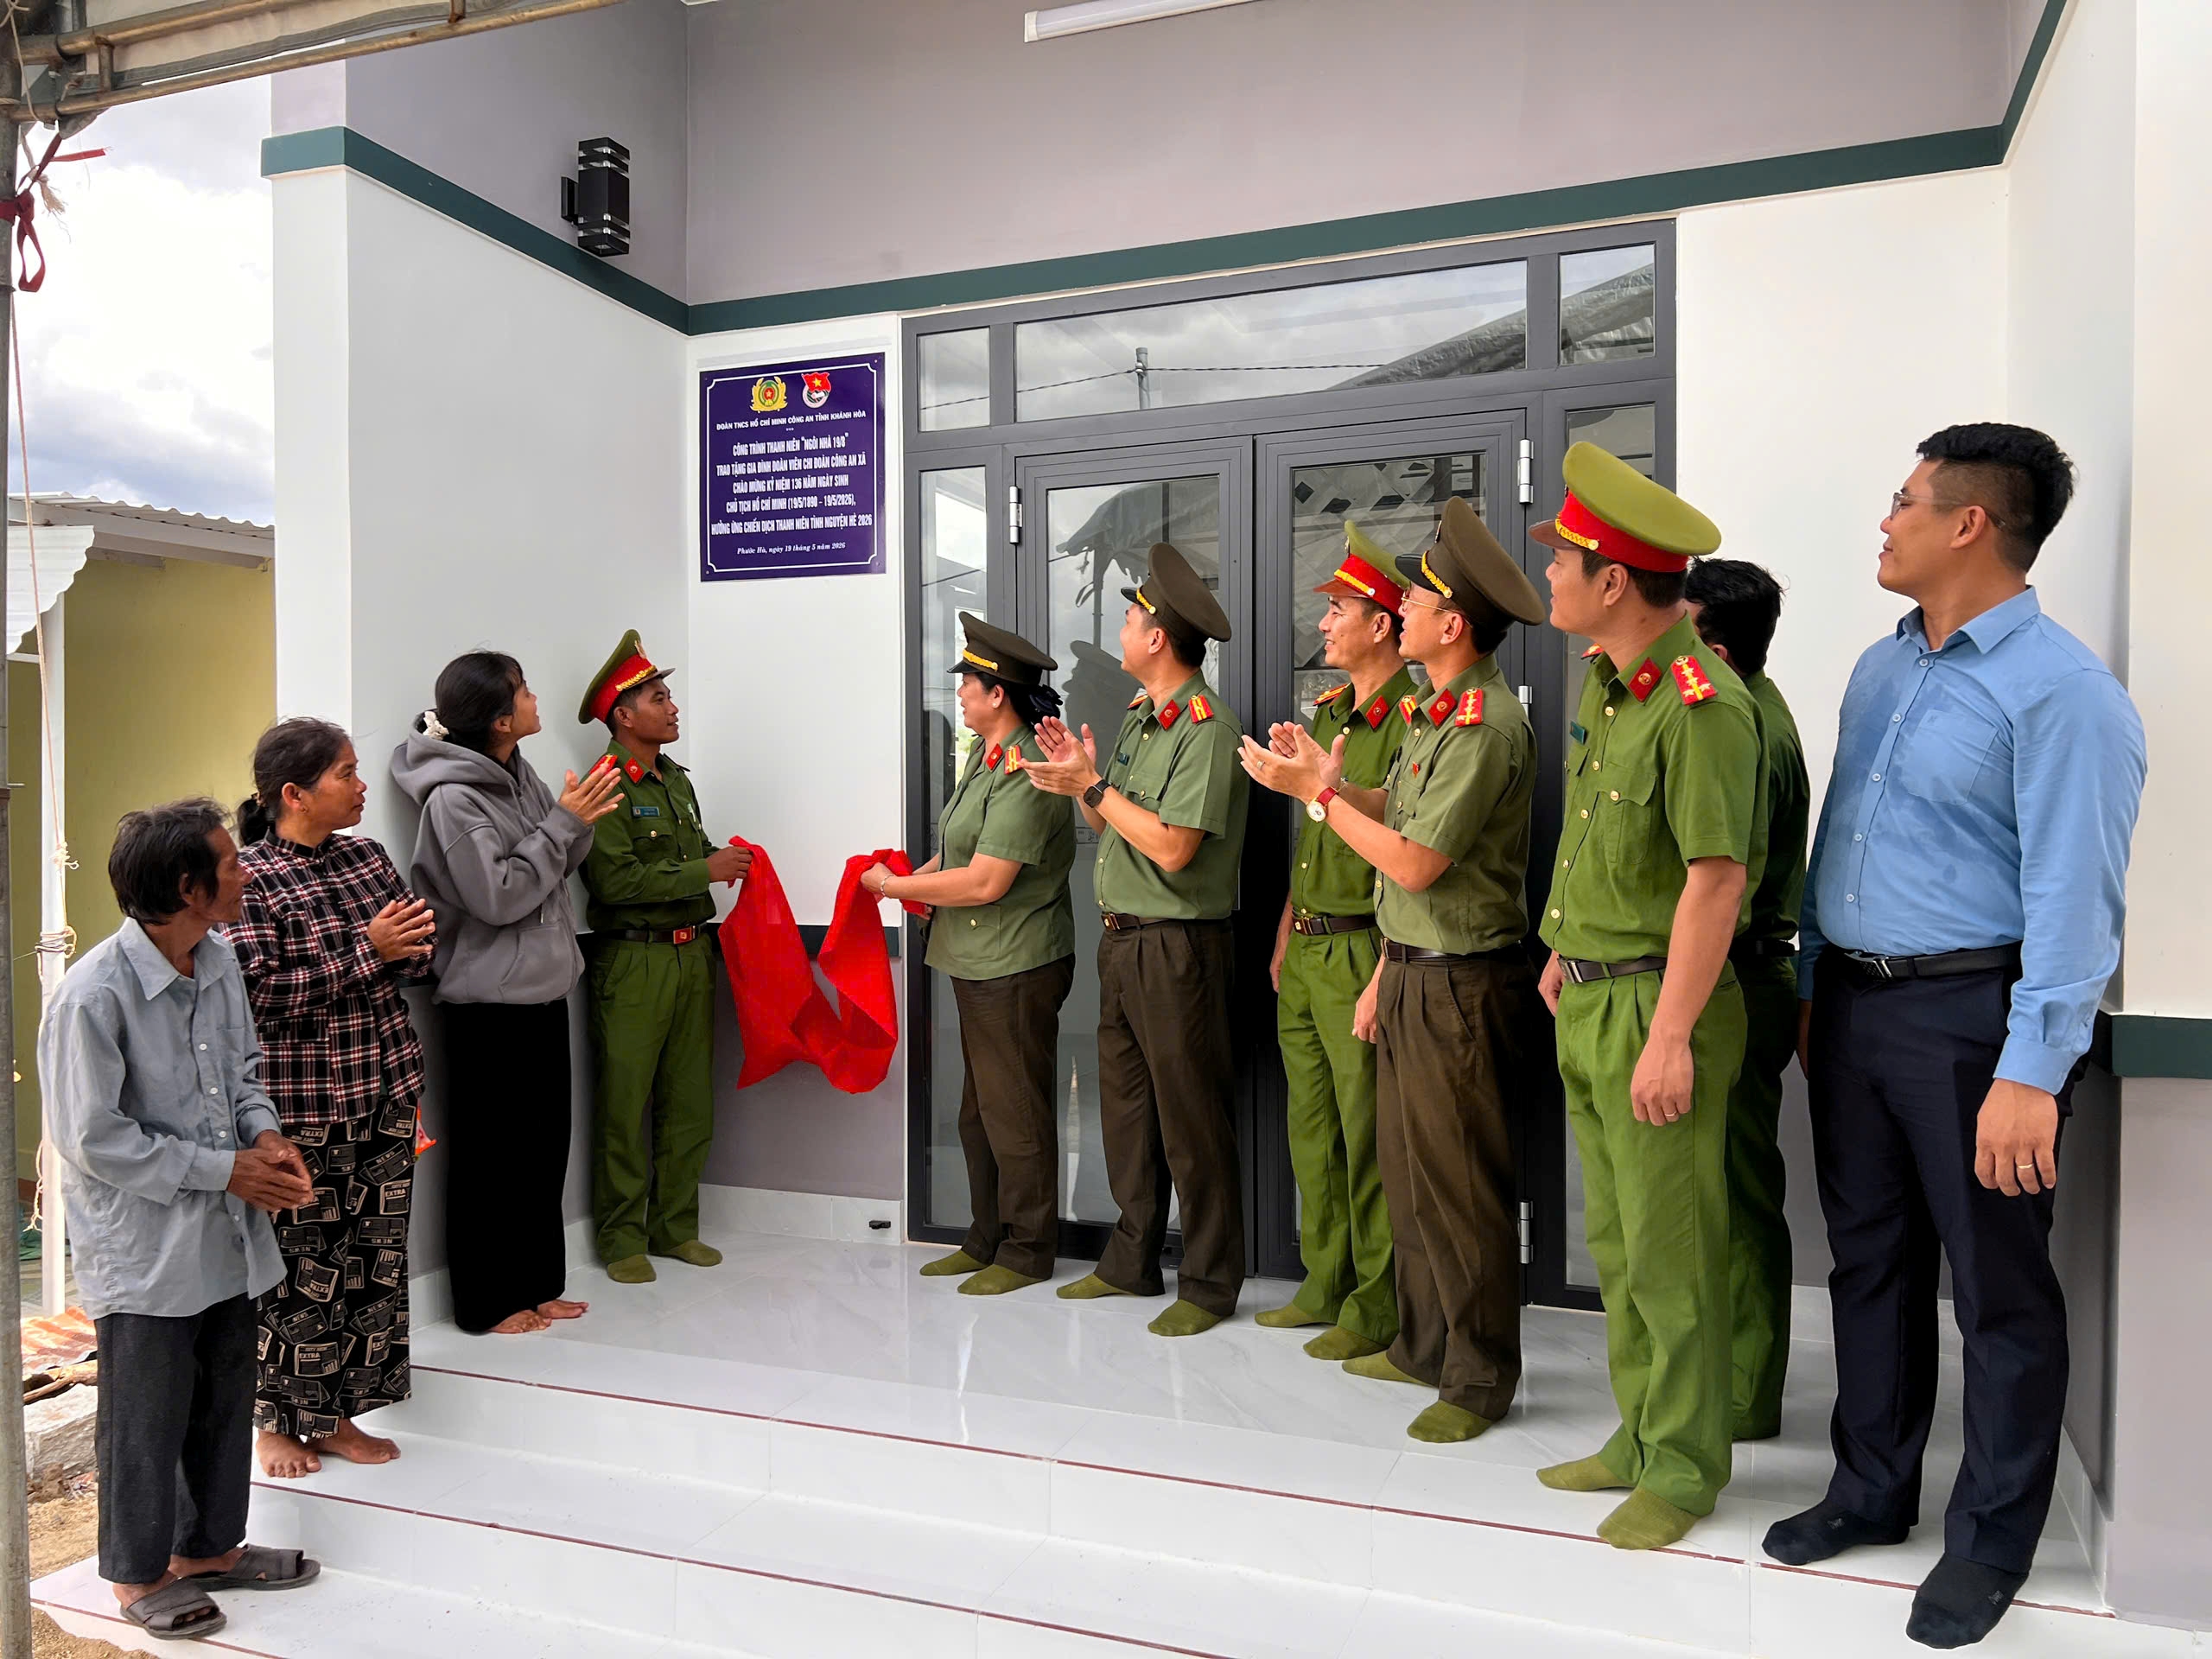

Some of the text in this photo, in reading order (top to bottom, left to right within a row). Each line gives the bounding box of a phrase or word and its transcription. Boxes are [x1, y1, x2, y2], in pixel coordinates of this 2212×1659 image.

[716, 422, 733, 430] ĐOÀN
[734, 421, 749, 429] TNCS
[750, 417, 759, 427] HỒ
[760, 417, 771, 427] CHÍ
[771, 417, 787, 426] MINH
[787, 415, 804, 424] CÔNG
[830, 410, 852, 421] KHÁNH
[853, 409, 867, 418] HÒA
[733, 442, 748, 457] CÔNG
[749, 441, 766, 455] TRÌNH
[766, 441, 785, 454] THANH
[785, 437, 801, 452] NIÊN
[819, 434, 832, 449] NHÀ
[716, 451, 867, 478] TRAO TẶNG GIA ĐÌNH ĐOÀN VIÊN CHI ĐOÀN CÔNG AN XÃ
[733, 480, 748, 494] CHÀO
[791, 477, 803, 490] 136
[803, 474, 817, 489] NĂM
[817, 473, 834, 488] NGÀY
[834, 474, 849, 487] SINH
[738, 500, 752, 515] TỊCH
[760, 496, 771, 512] CHÍ
[771, 498, 787, 511] MINH
[761, 519, 775, 535] DỊCH
[776, 518, 795, 531] THANH
[795, 515, 810, 531] NIÊN
[810, 514, 824, 530] TÌNH
[849, 512, 857, 527] HÈ
[857, 513, 873, 526] 2026
[385, 1188, 407, 1198] EXTRA
